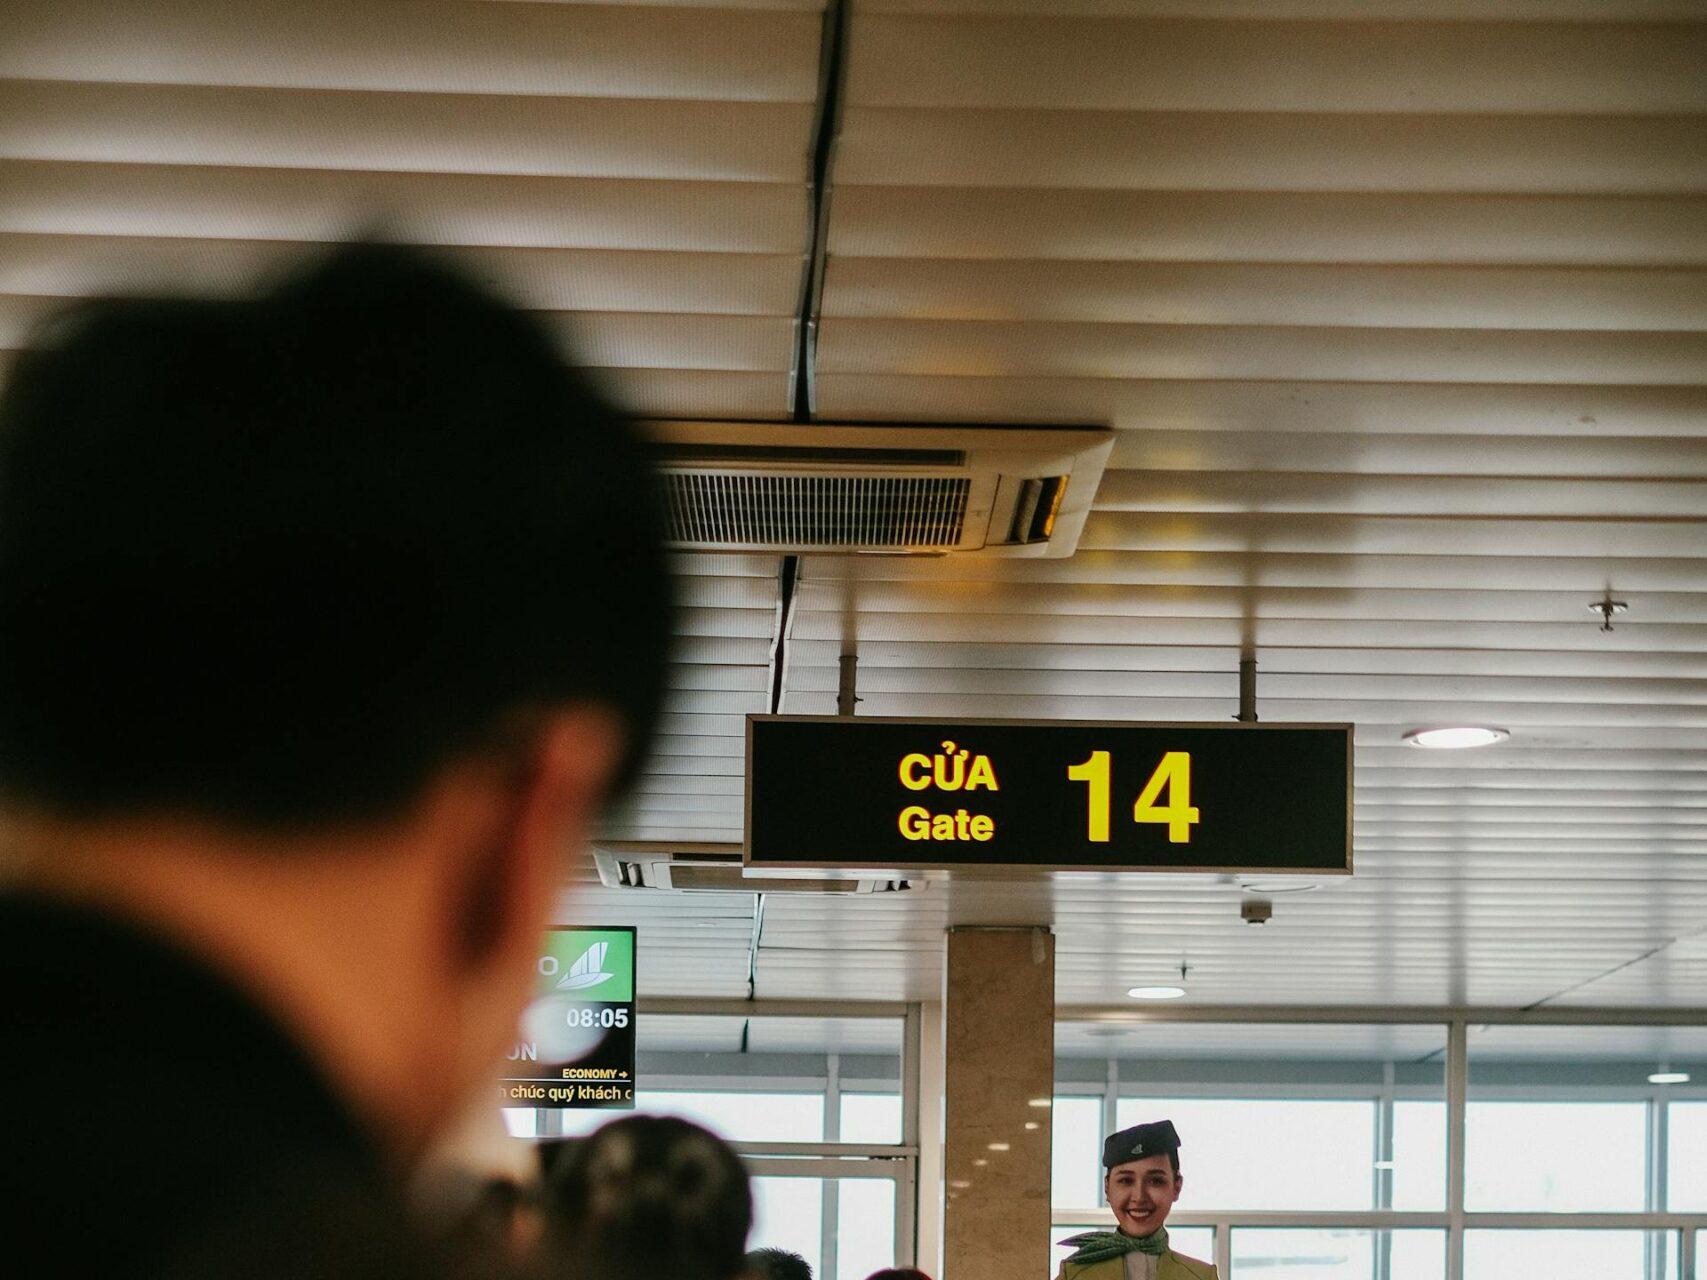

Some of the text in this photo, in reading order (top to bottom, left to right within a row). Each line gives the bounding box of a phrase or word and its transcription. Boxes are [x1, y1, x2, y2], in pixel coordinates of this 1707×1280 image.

[899, 740, 999, 791] CỬA
[1068, 750, 1199, 843] 14
[898, 805, 994, 841] Gate
[567, 1008, 628, 1028] 08:05
[562, 1068, 617, 1079] ECONOMY
[510, 1084, 545, 1098] chúc
[549, 1087, 575, 1101] quý
[578, 1086, 621, 1099] khách
